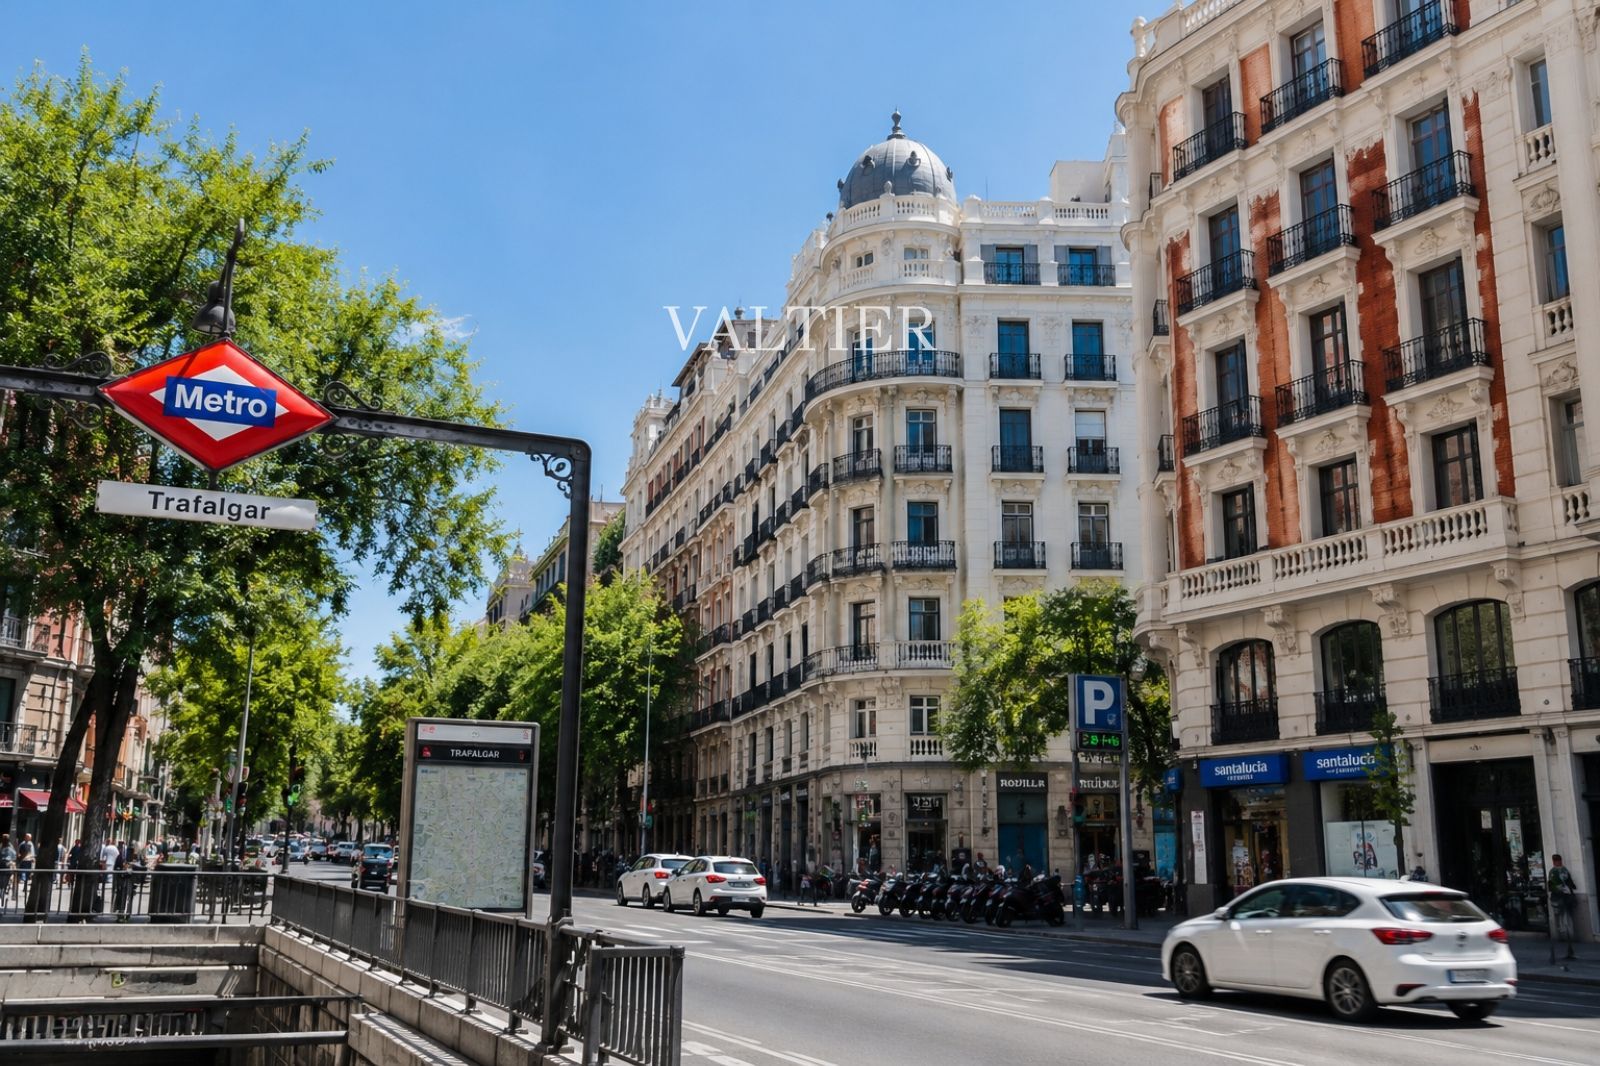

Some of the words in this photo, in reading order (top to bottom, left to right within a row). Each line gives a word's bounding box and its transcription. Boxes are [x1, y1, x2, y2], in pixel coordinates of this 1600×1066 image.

[174, 383, 268, 418] Metro
[148, 490, 271, 522] Trafalgar
[1083, 680, 1115, 725] P
[450, 748, 500, 758] TRAFALGAR
[1214, 760, 1268, 776] santalucia
